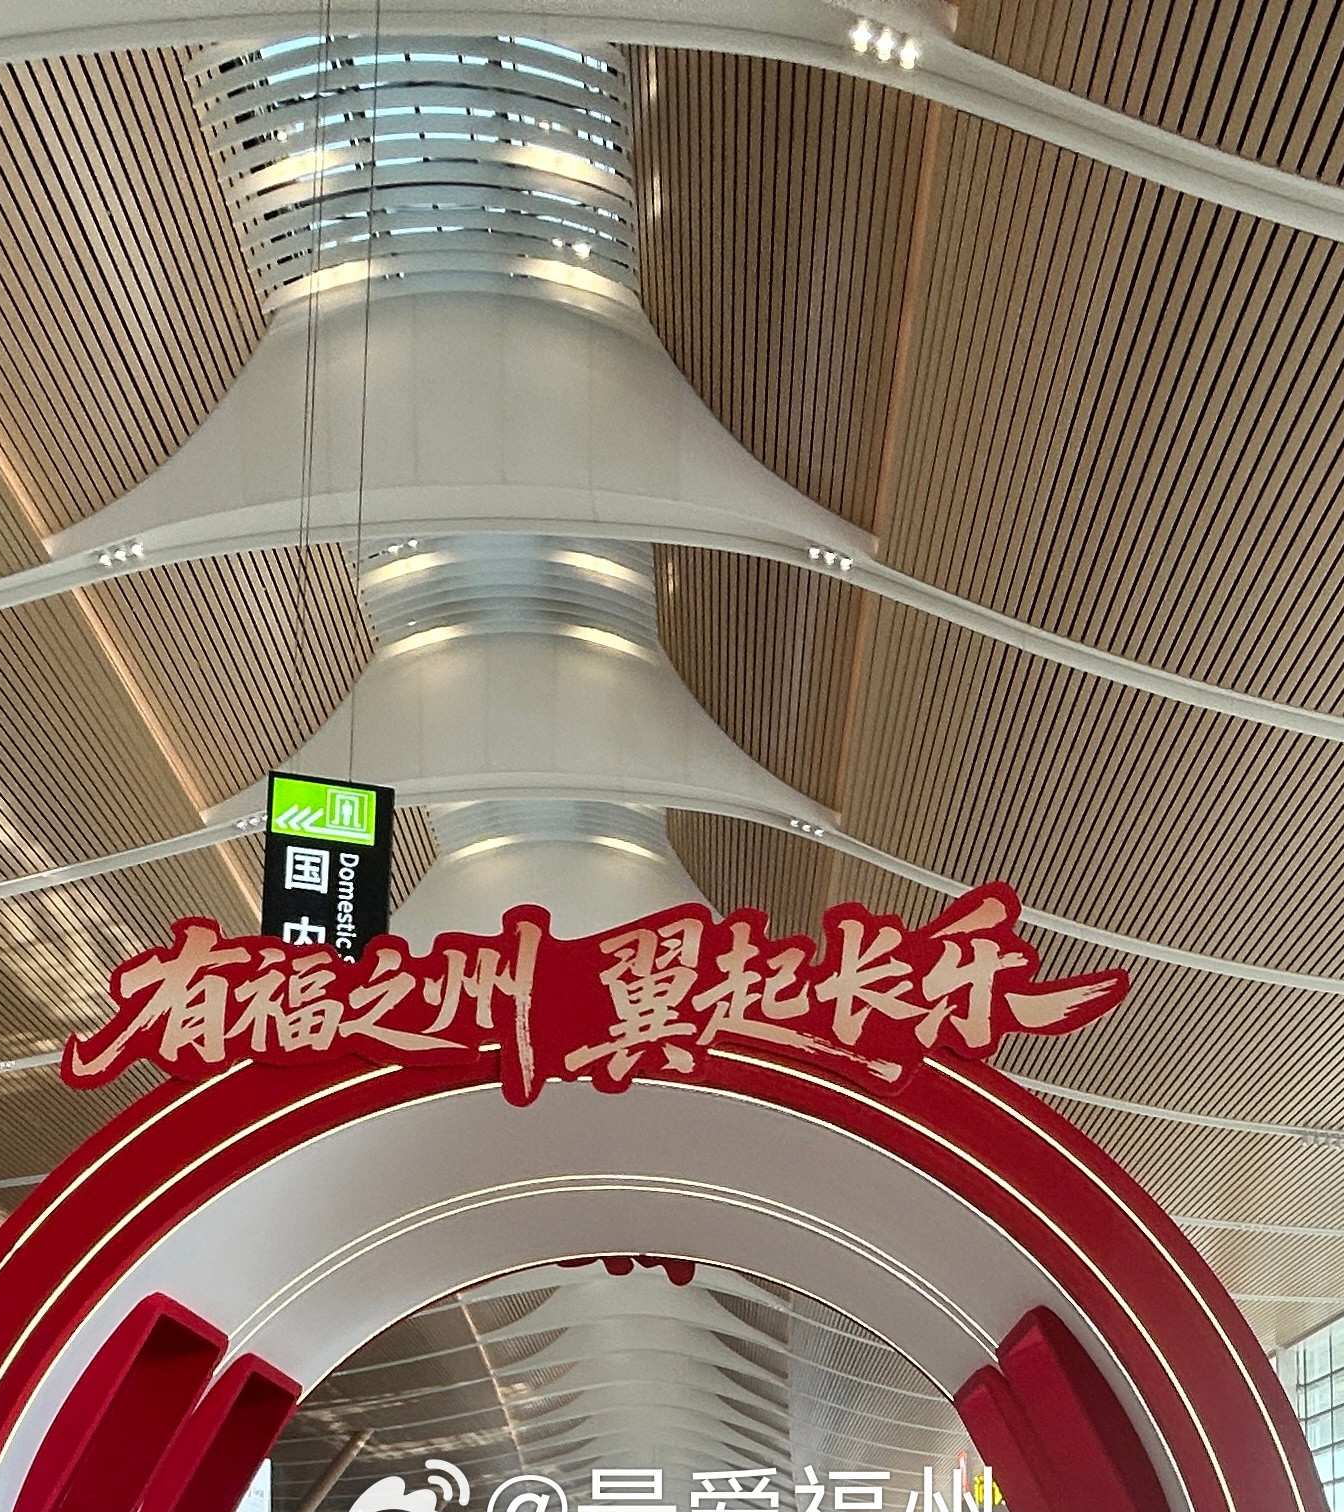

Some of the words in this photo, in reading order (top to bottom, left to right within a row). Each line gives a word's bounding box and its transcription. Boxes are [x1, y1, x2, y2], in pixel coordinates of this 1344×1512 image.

[336, 852, 360, 950] Domestic
[64, 920, 536, 1100] 有福之州
[564, 896, 1120, 1084] 翼起长乐
